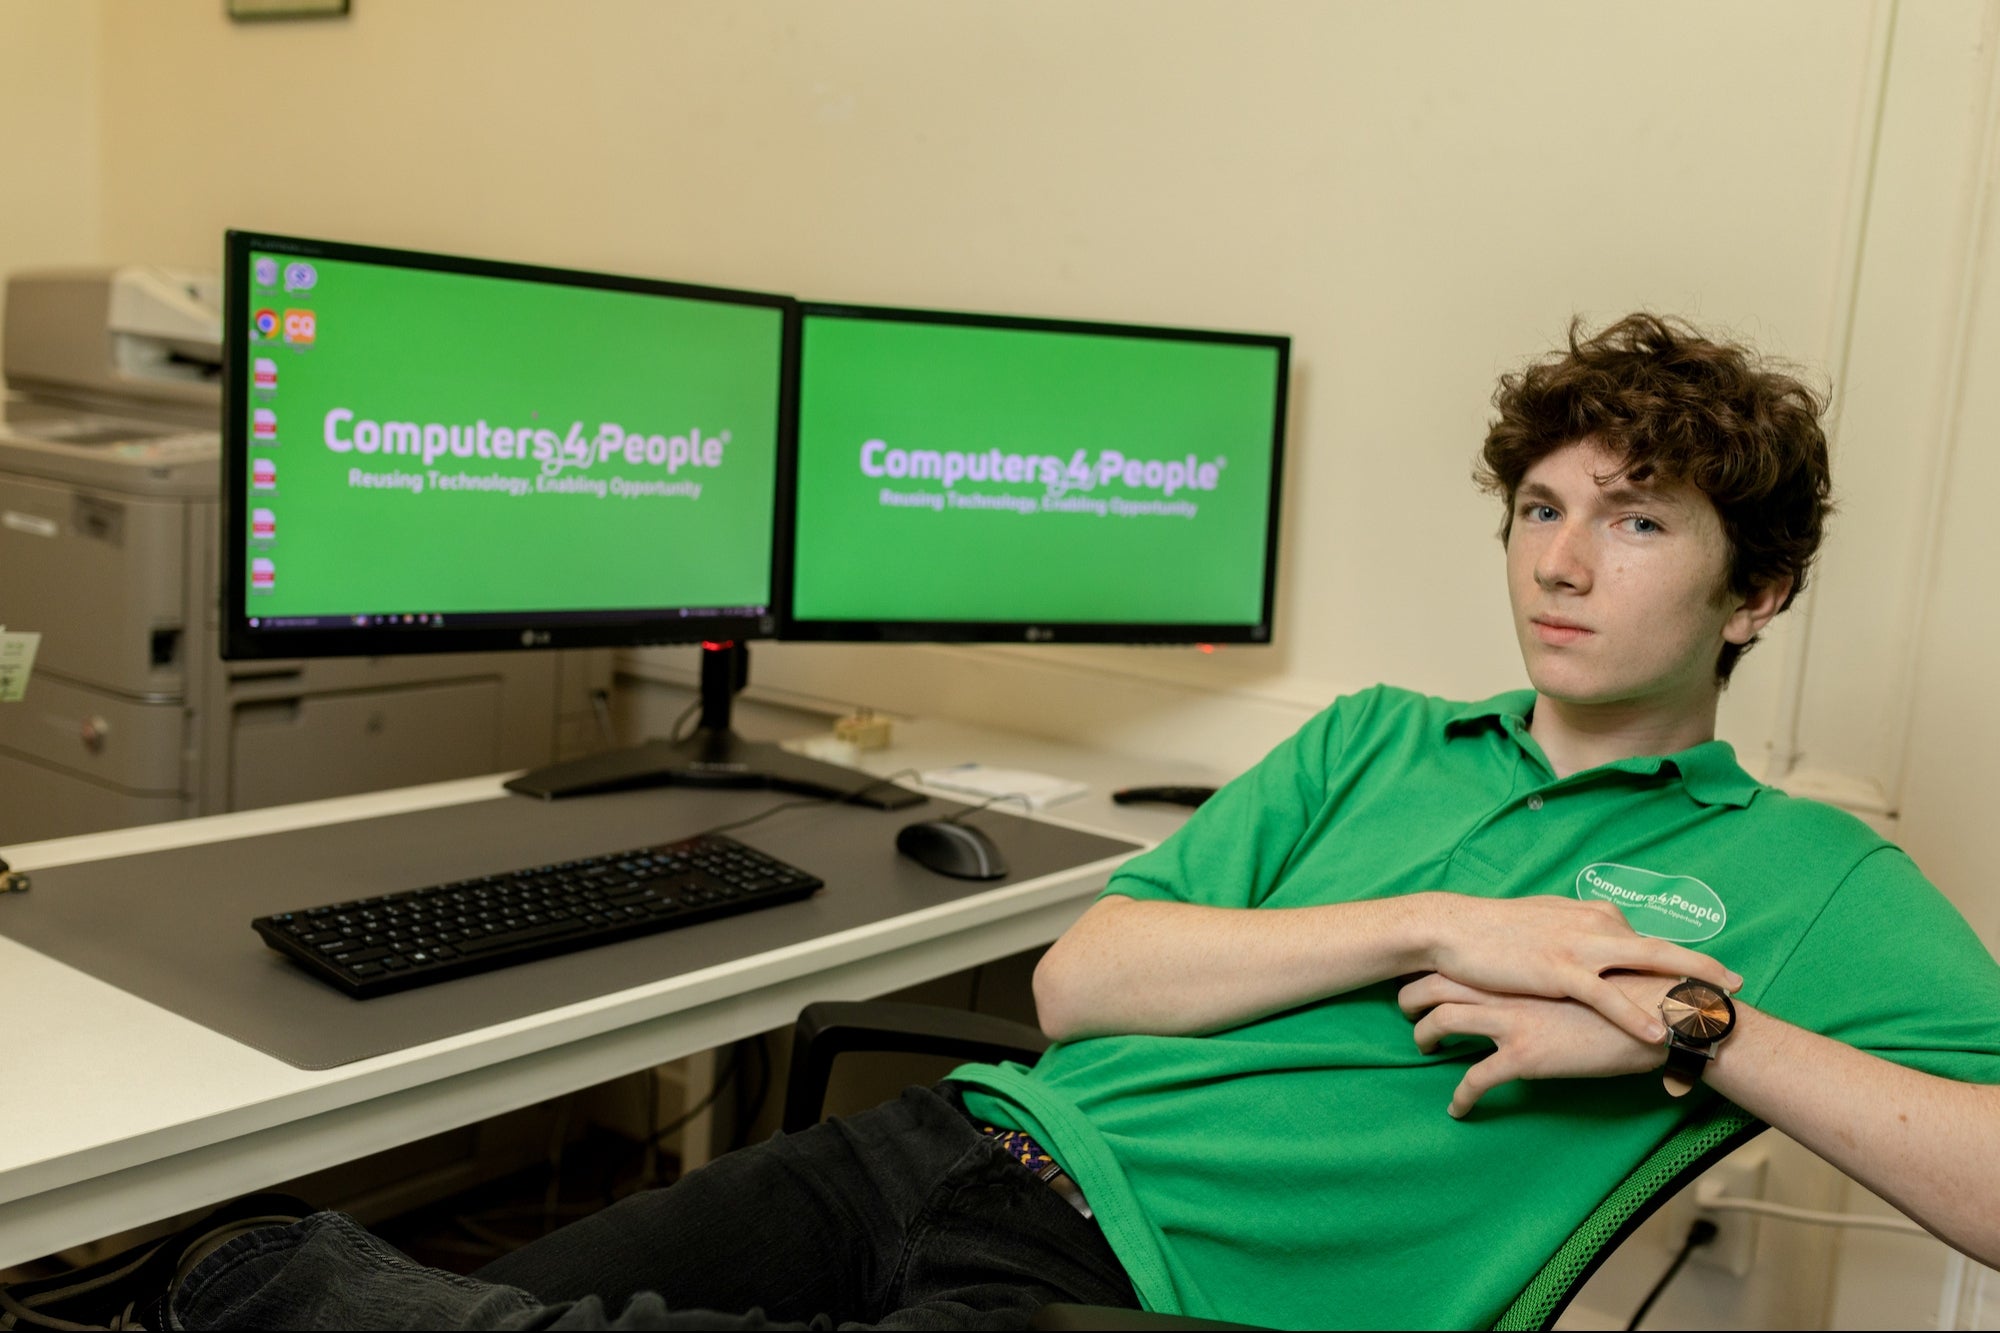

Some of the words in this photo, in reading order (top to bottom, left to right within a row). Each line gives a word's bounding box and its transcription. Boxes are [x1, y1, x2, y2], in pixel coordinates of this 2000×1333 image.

[349, 467, 423, 494] Reusing
[427, 470, 534, 496] Technology,
[536, 474, 608, 499] Enabling
[609, 476, 702, 500] Opportunity
